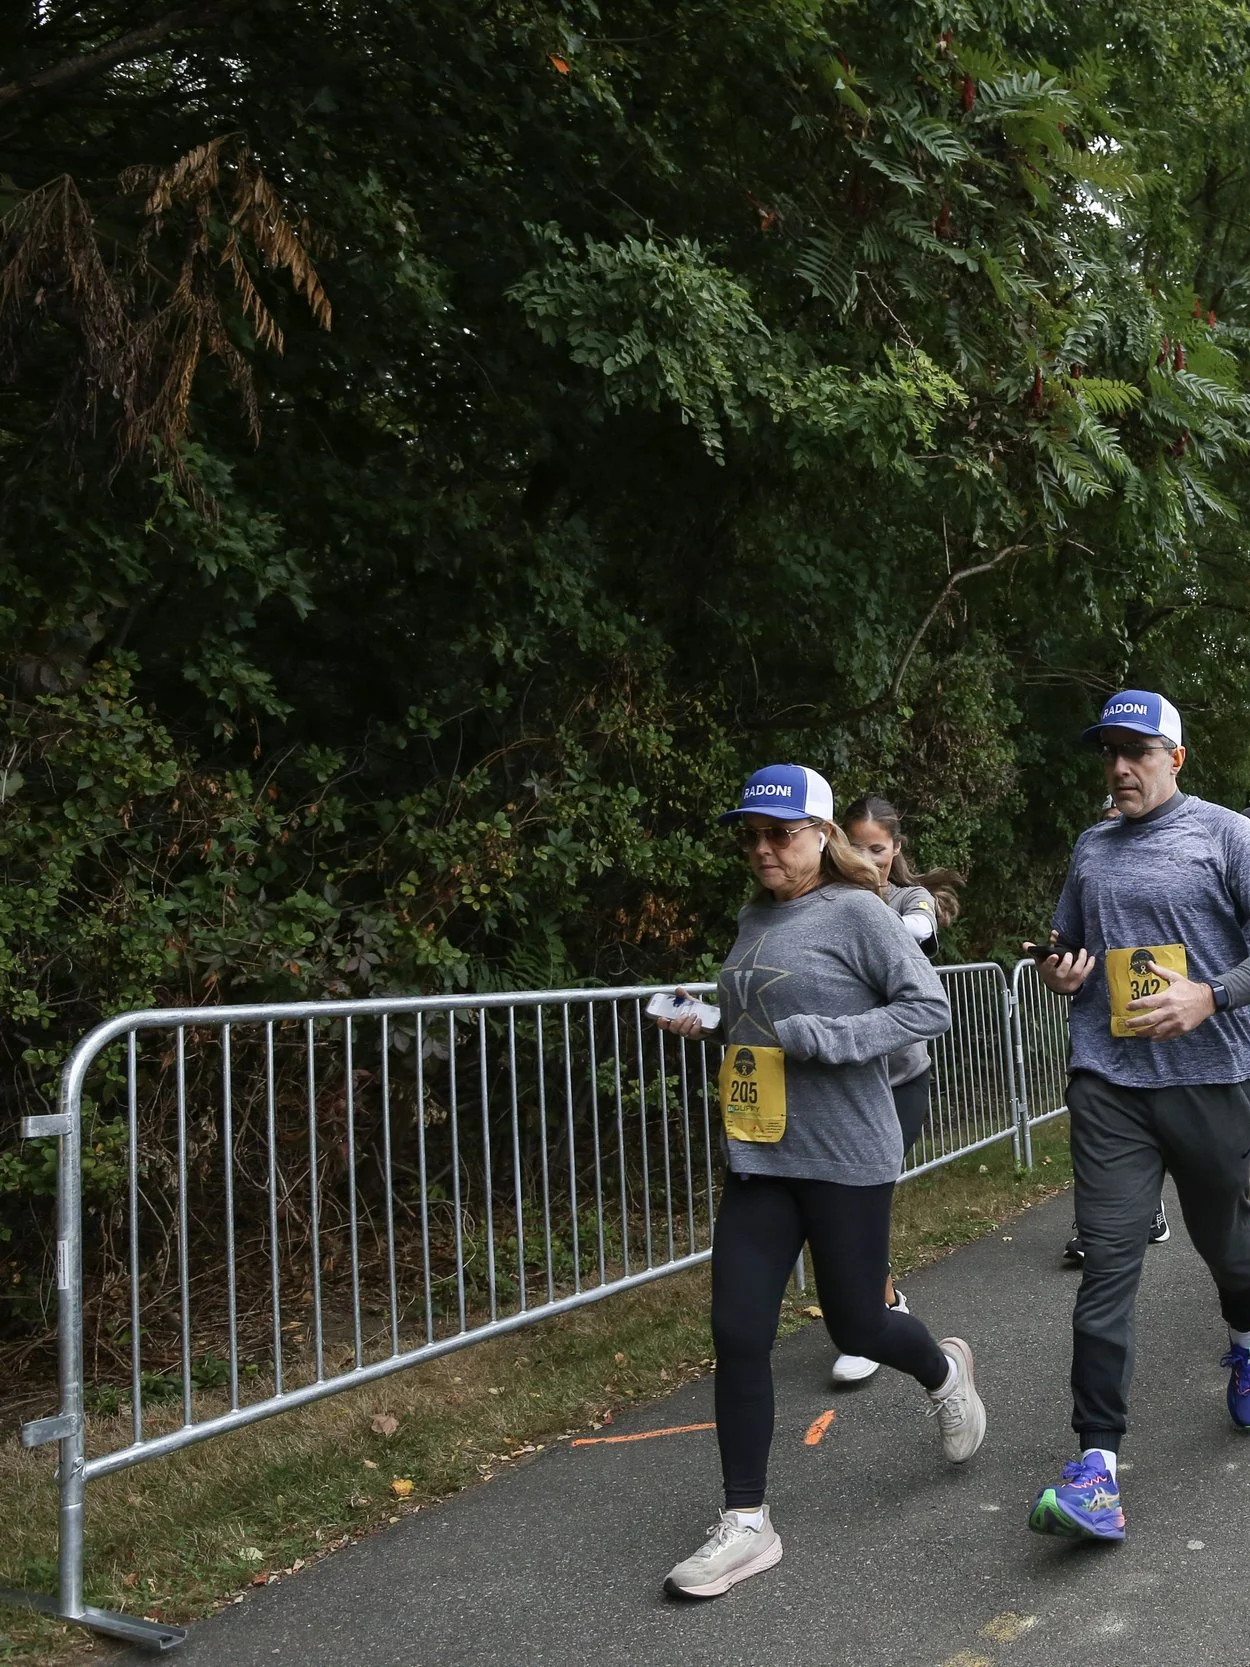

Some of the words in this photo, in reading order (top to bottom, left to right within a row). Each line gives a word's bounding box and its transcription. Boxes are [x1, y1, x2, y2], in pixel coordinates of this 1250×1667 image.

[1103, 704, 1145, 719] RADON
[744, 784, 787, 799] RADON
[733, 970, 754, 1010] V
[1130, 978, 1160, 1000] 342
[731, 1080, 758, 1104] 205
